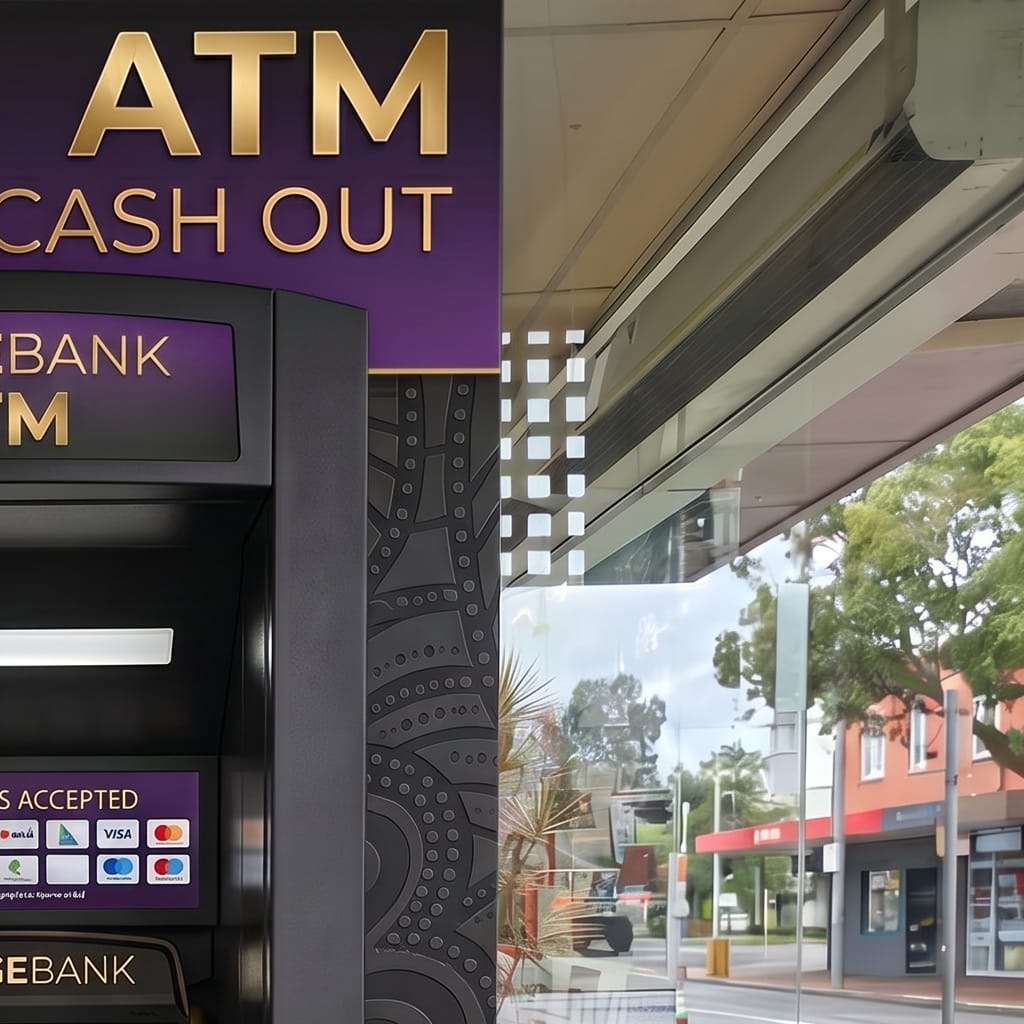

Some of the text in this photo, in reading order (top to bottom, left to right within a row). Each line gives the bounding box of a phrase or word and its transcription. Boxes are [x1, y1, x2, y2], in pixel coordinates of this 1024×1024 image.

[67, 29, 448, 156] ATM
[262, 187, 453, 254] OUT
[17, 789, 139, 811] ACCEPTED
[103, 828, 132, 840] VISA
